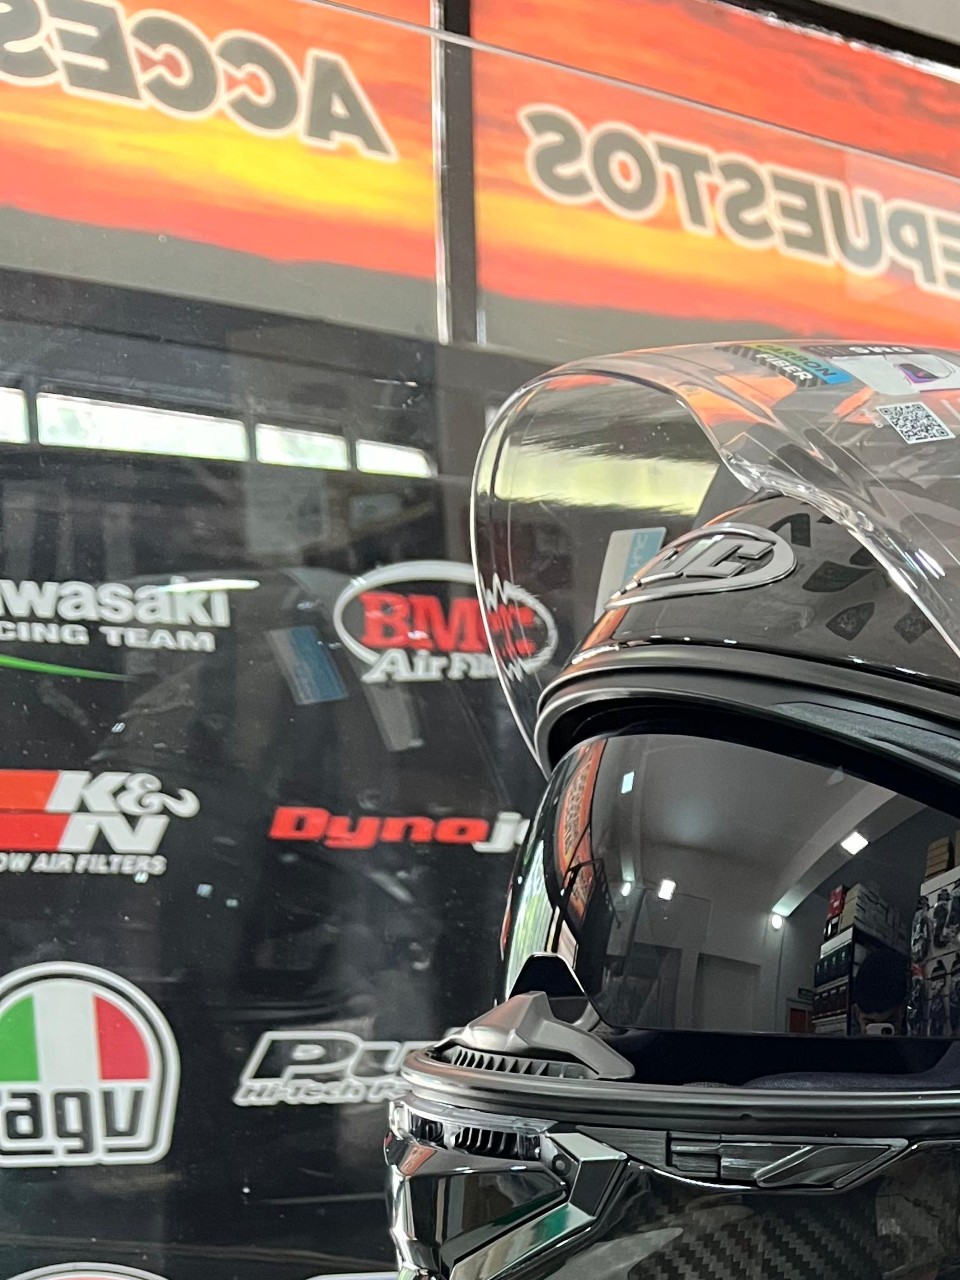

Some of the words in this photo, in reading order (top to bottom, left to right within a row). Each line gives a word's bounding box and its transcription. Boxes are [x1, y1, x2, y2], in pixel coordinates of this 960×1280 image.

[755, 344, 838, 378] CARBON
[755, 352, 815, 382] FIBER
[0, 575, 231, 627] wasaki
[98, 625, 216, 652] TEAM
[359, 590, 537, 656] BMC
[361, 648, 448, 685] Air
[269, 805, 531, 853] Dynoj
[31, 854, 76, 874] AIR
[74, 854, 168, 876] FILTERS
[4, 1088, 145, 1154] agv
